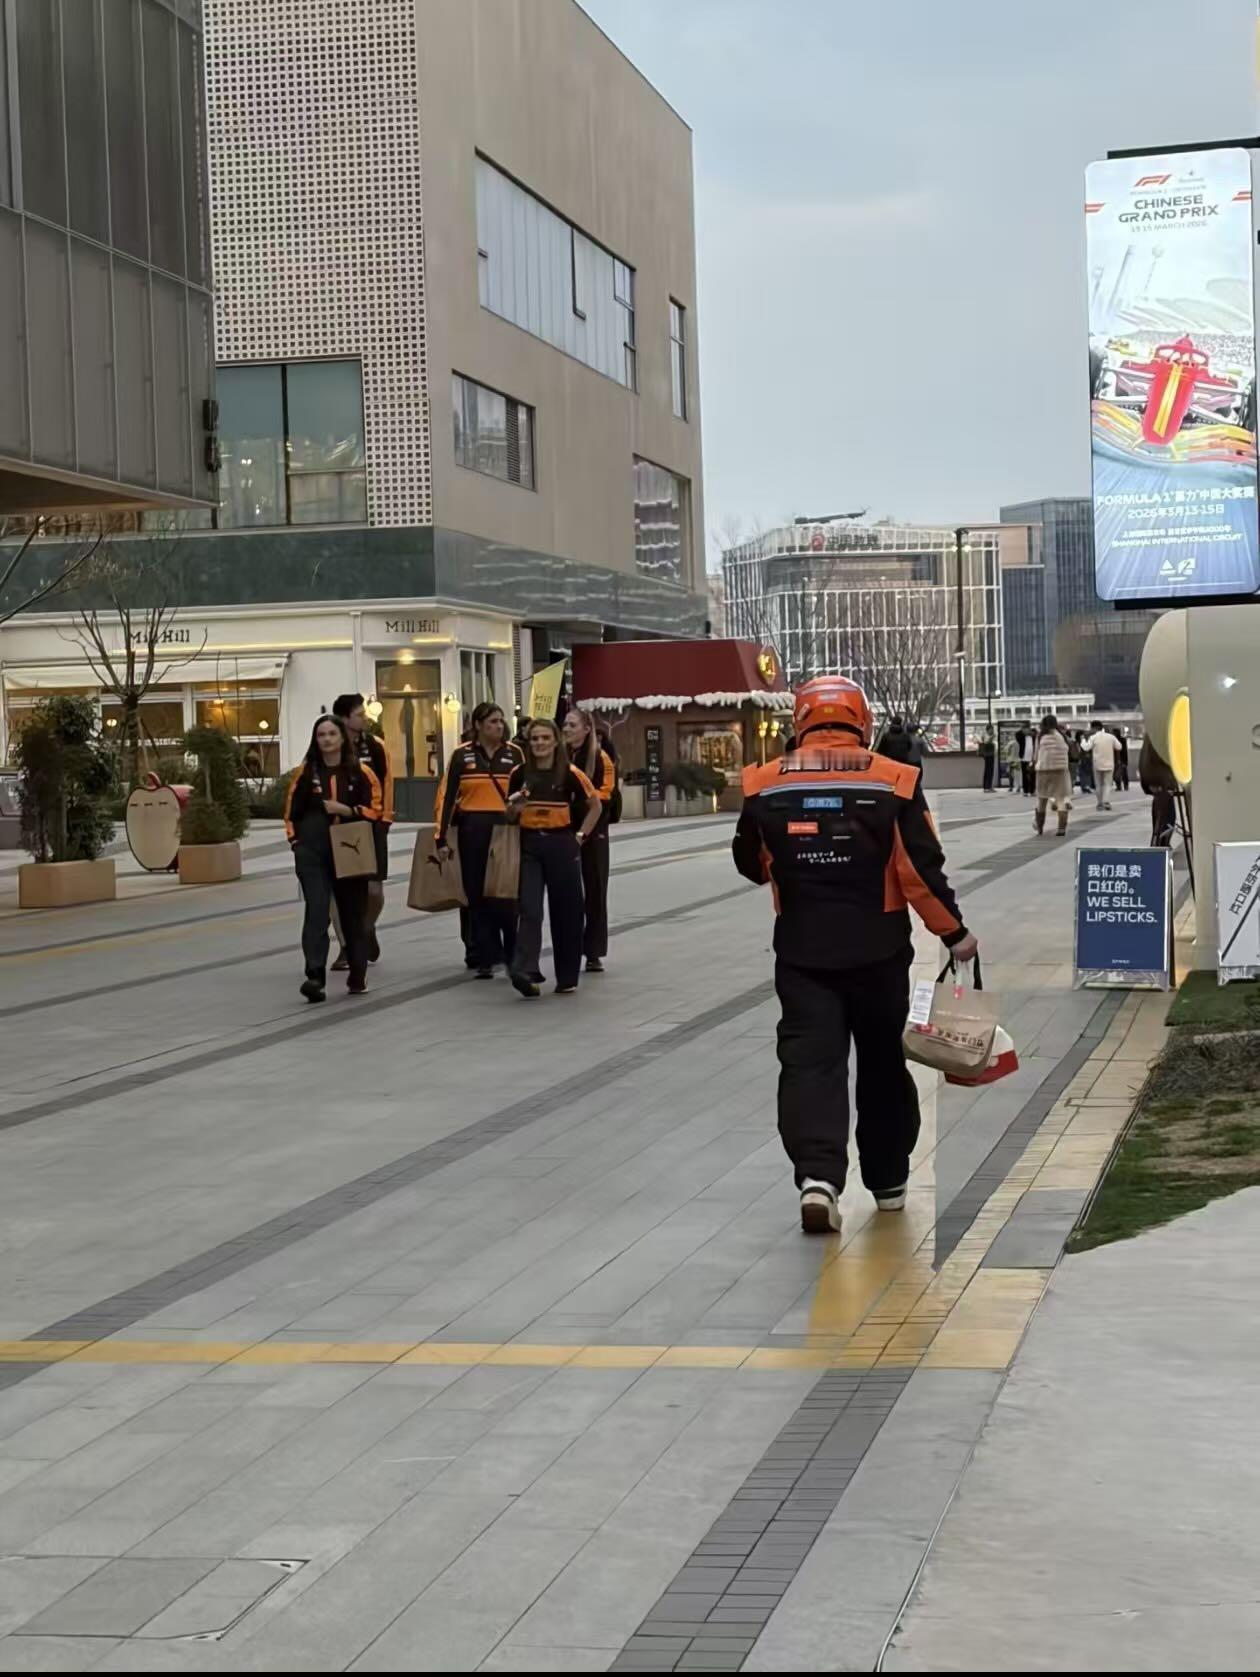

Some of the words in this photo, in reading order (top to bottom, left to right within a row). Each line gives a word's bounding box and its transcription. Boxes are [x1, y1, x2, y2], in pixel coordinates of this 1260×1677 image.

[1134, 194, 1203, 210] CHINESE
[1119, 209, 1176, 223] GRAND
[1179, 204, 1219, 218] PRIX
[1095, 491, 1162, 507] FORMULA
[385, 620, 415, 633] Mill
[416, 619, 440, 633] Hill
[161, 629, 190, 643] Hill
[1087, 864, 1142, 878] 我们是卖
[1087, 880, 1135, 894] 口红的。
[1086, 896, 1109, 908] WE
[1112, 896, 1146, 908] SELL
[1086, 911, 1158, 923] LIPSTICKS.
